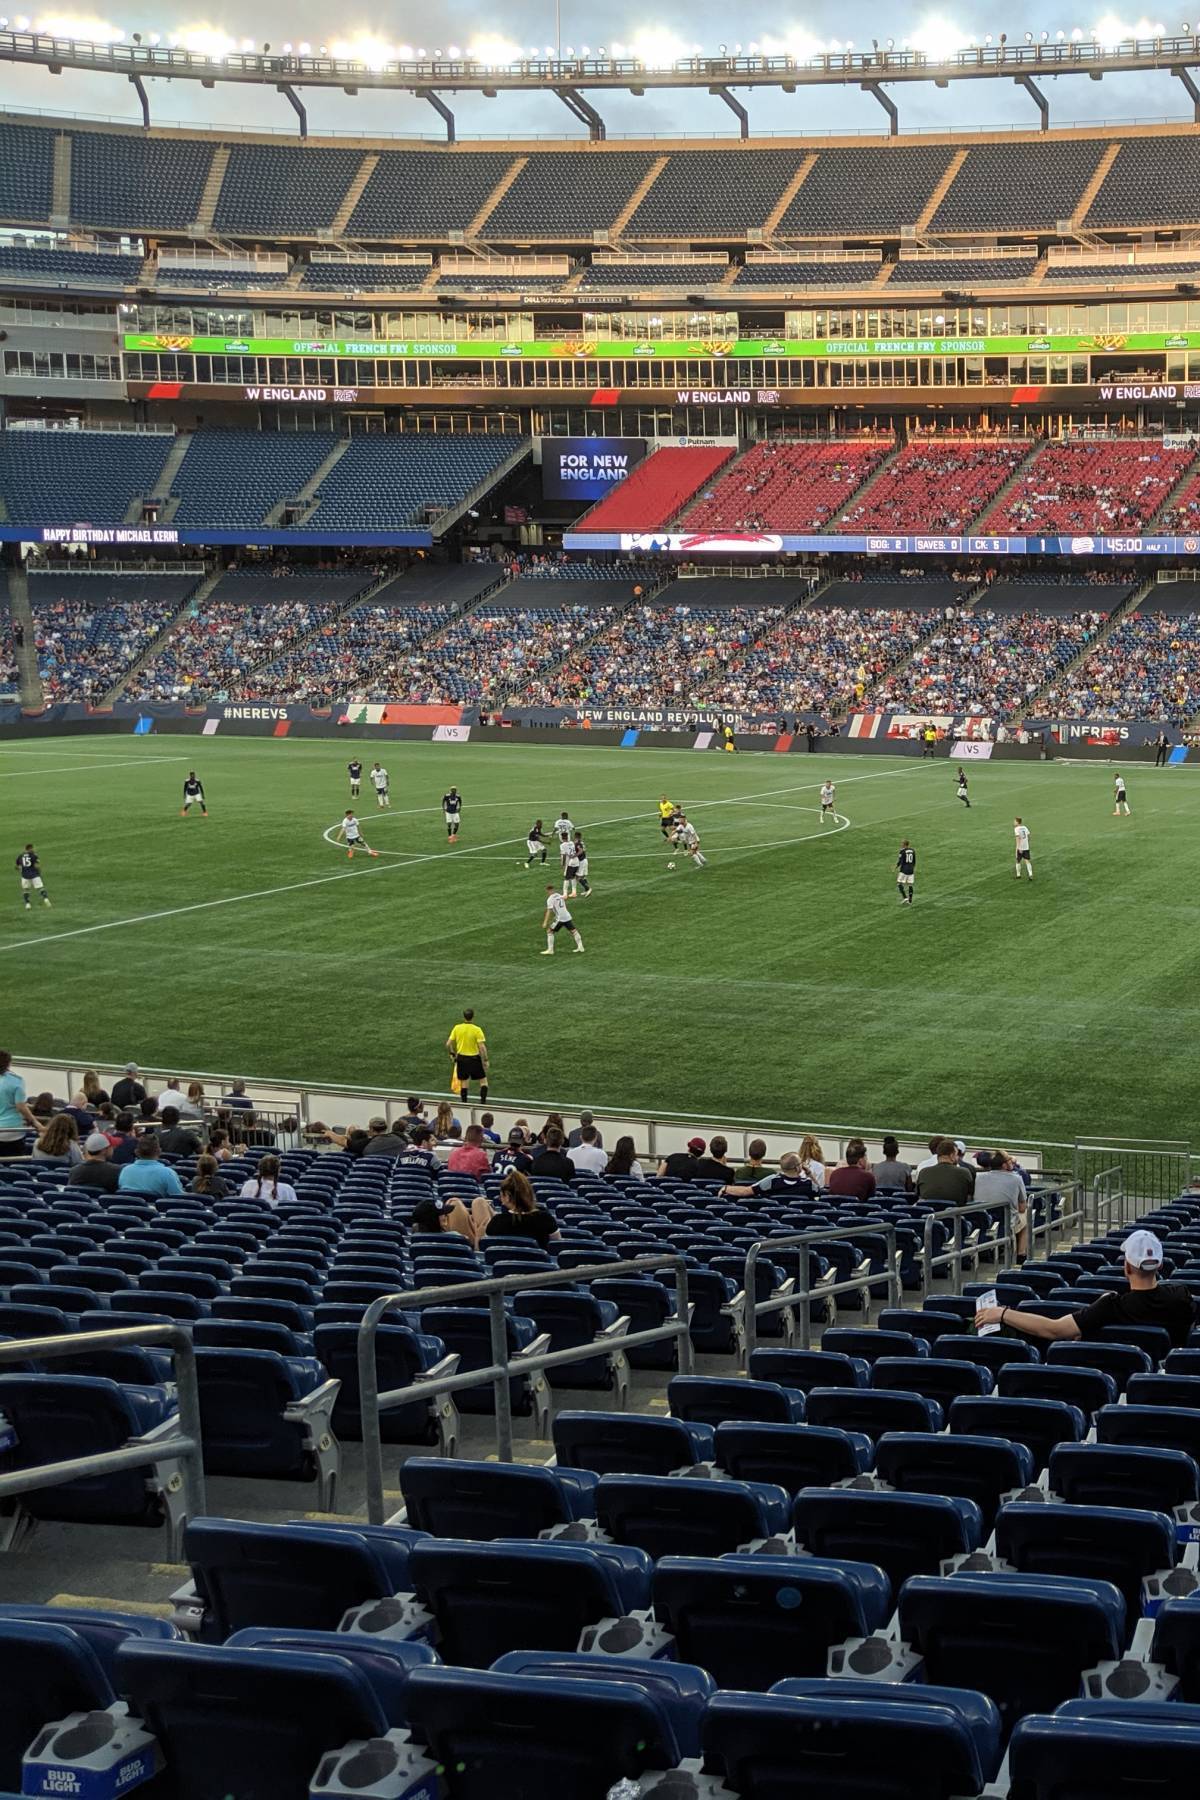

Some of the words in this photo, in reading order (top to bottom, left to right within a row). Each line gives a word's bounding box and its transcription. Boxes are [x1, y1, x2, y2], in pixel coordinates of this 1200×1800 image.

[345, 344, 388, 354] FRENCH
[390, 344, 408, 354] FRY
[413, 344, 458, 354] SPONSOR
[826, 343, 869, 353] OFFICIAL
[874, 342, 915, 352] FRENCH
[918, 342, 936, 351] FRY
[941, 341, 985, 351] SPONSOR
[263, 388, 326, 401] ENGLAND
[692, 391, 751, 403] ENGLAND
[1116, 386, 1177, 399] ENGLAND
[559, 455, 589, 467] FOR
[593, 455, 628, 467] NEW
[560, 468, 629, 481] ENGLAND
[43, 528, 71, 541] HAPPY
[73, 529, 115, 542] BIRTHDAY
[116, 530, 152, 542] MICHAEL
[153, 530, 179, 543] KERN!
[870, 540, 890, 549] SOG:
[895, 540, 901, 549] 2
[917, 540, 946, 550] SAVES:
[951, 540, 958, 550] 0
[975, 540, 989, 550] CK:
[993, 540, 1000, 550] 5
[1040, 539, 1046, 551] 1
[1107, 538, 1142, 551] 45:00
[224, 707, 288, 720] #NEREVS
[576, 711, 603, 720] NEW
[607, 711, 663, 722] ENGLAND
[22, 856, 32, 867] 15
[905, 853, 913, 863] 10
[119, 1760, 141, 1778] BUD
[47, 1769, 76, 1782] BUD
[115, 1765, 145, 1788] LIGHT
[42, 1779, 82, 1793] LIGHT
